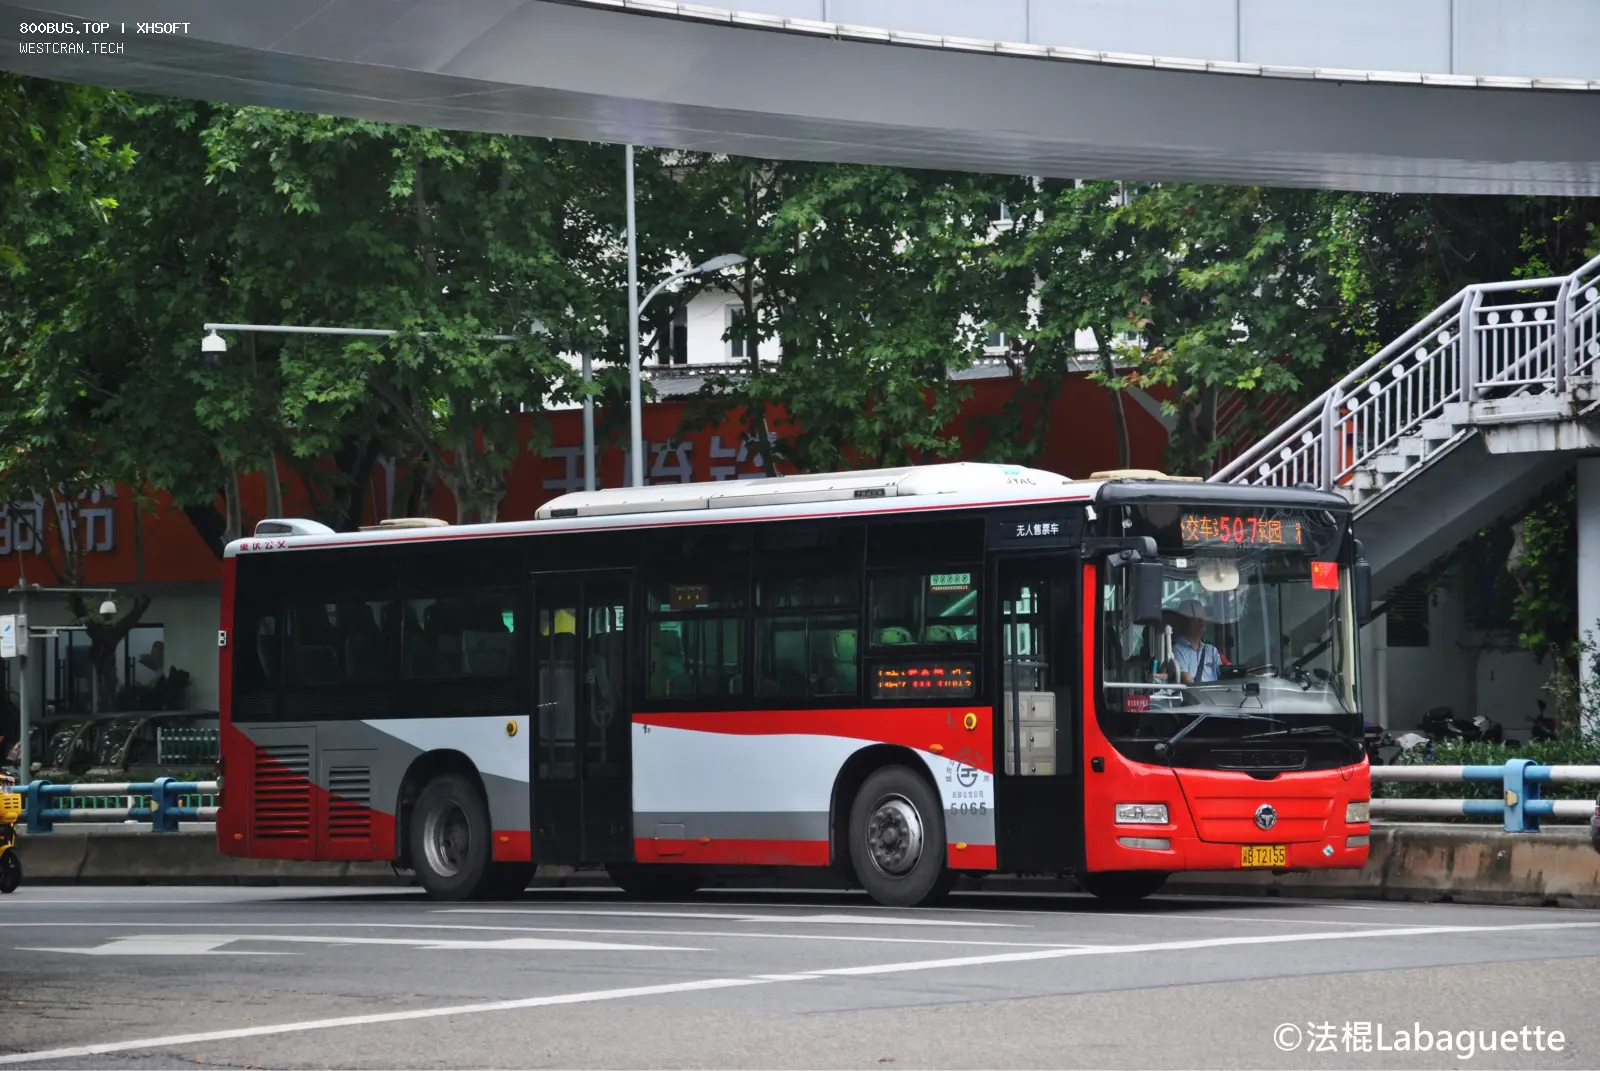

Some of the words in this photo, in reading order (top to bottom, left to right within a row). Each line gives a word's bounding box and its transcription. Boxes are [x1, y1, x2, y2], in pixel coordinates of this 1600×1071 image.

[1016, 522, 1059, 537] 无人售票车
[1219, 516, 1257, 544] 507
[950, 802, 987, 816] 5065
